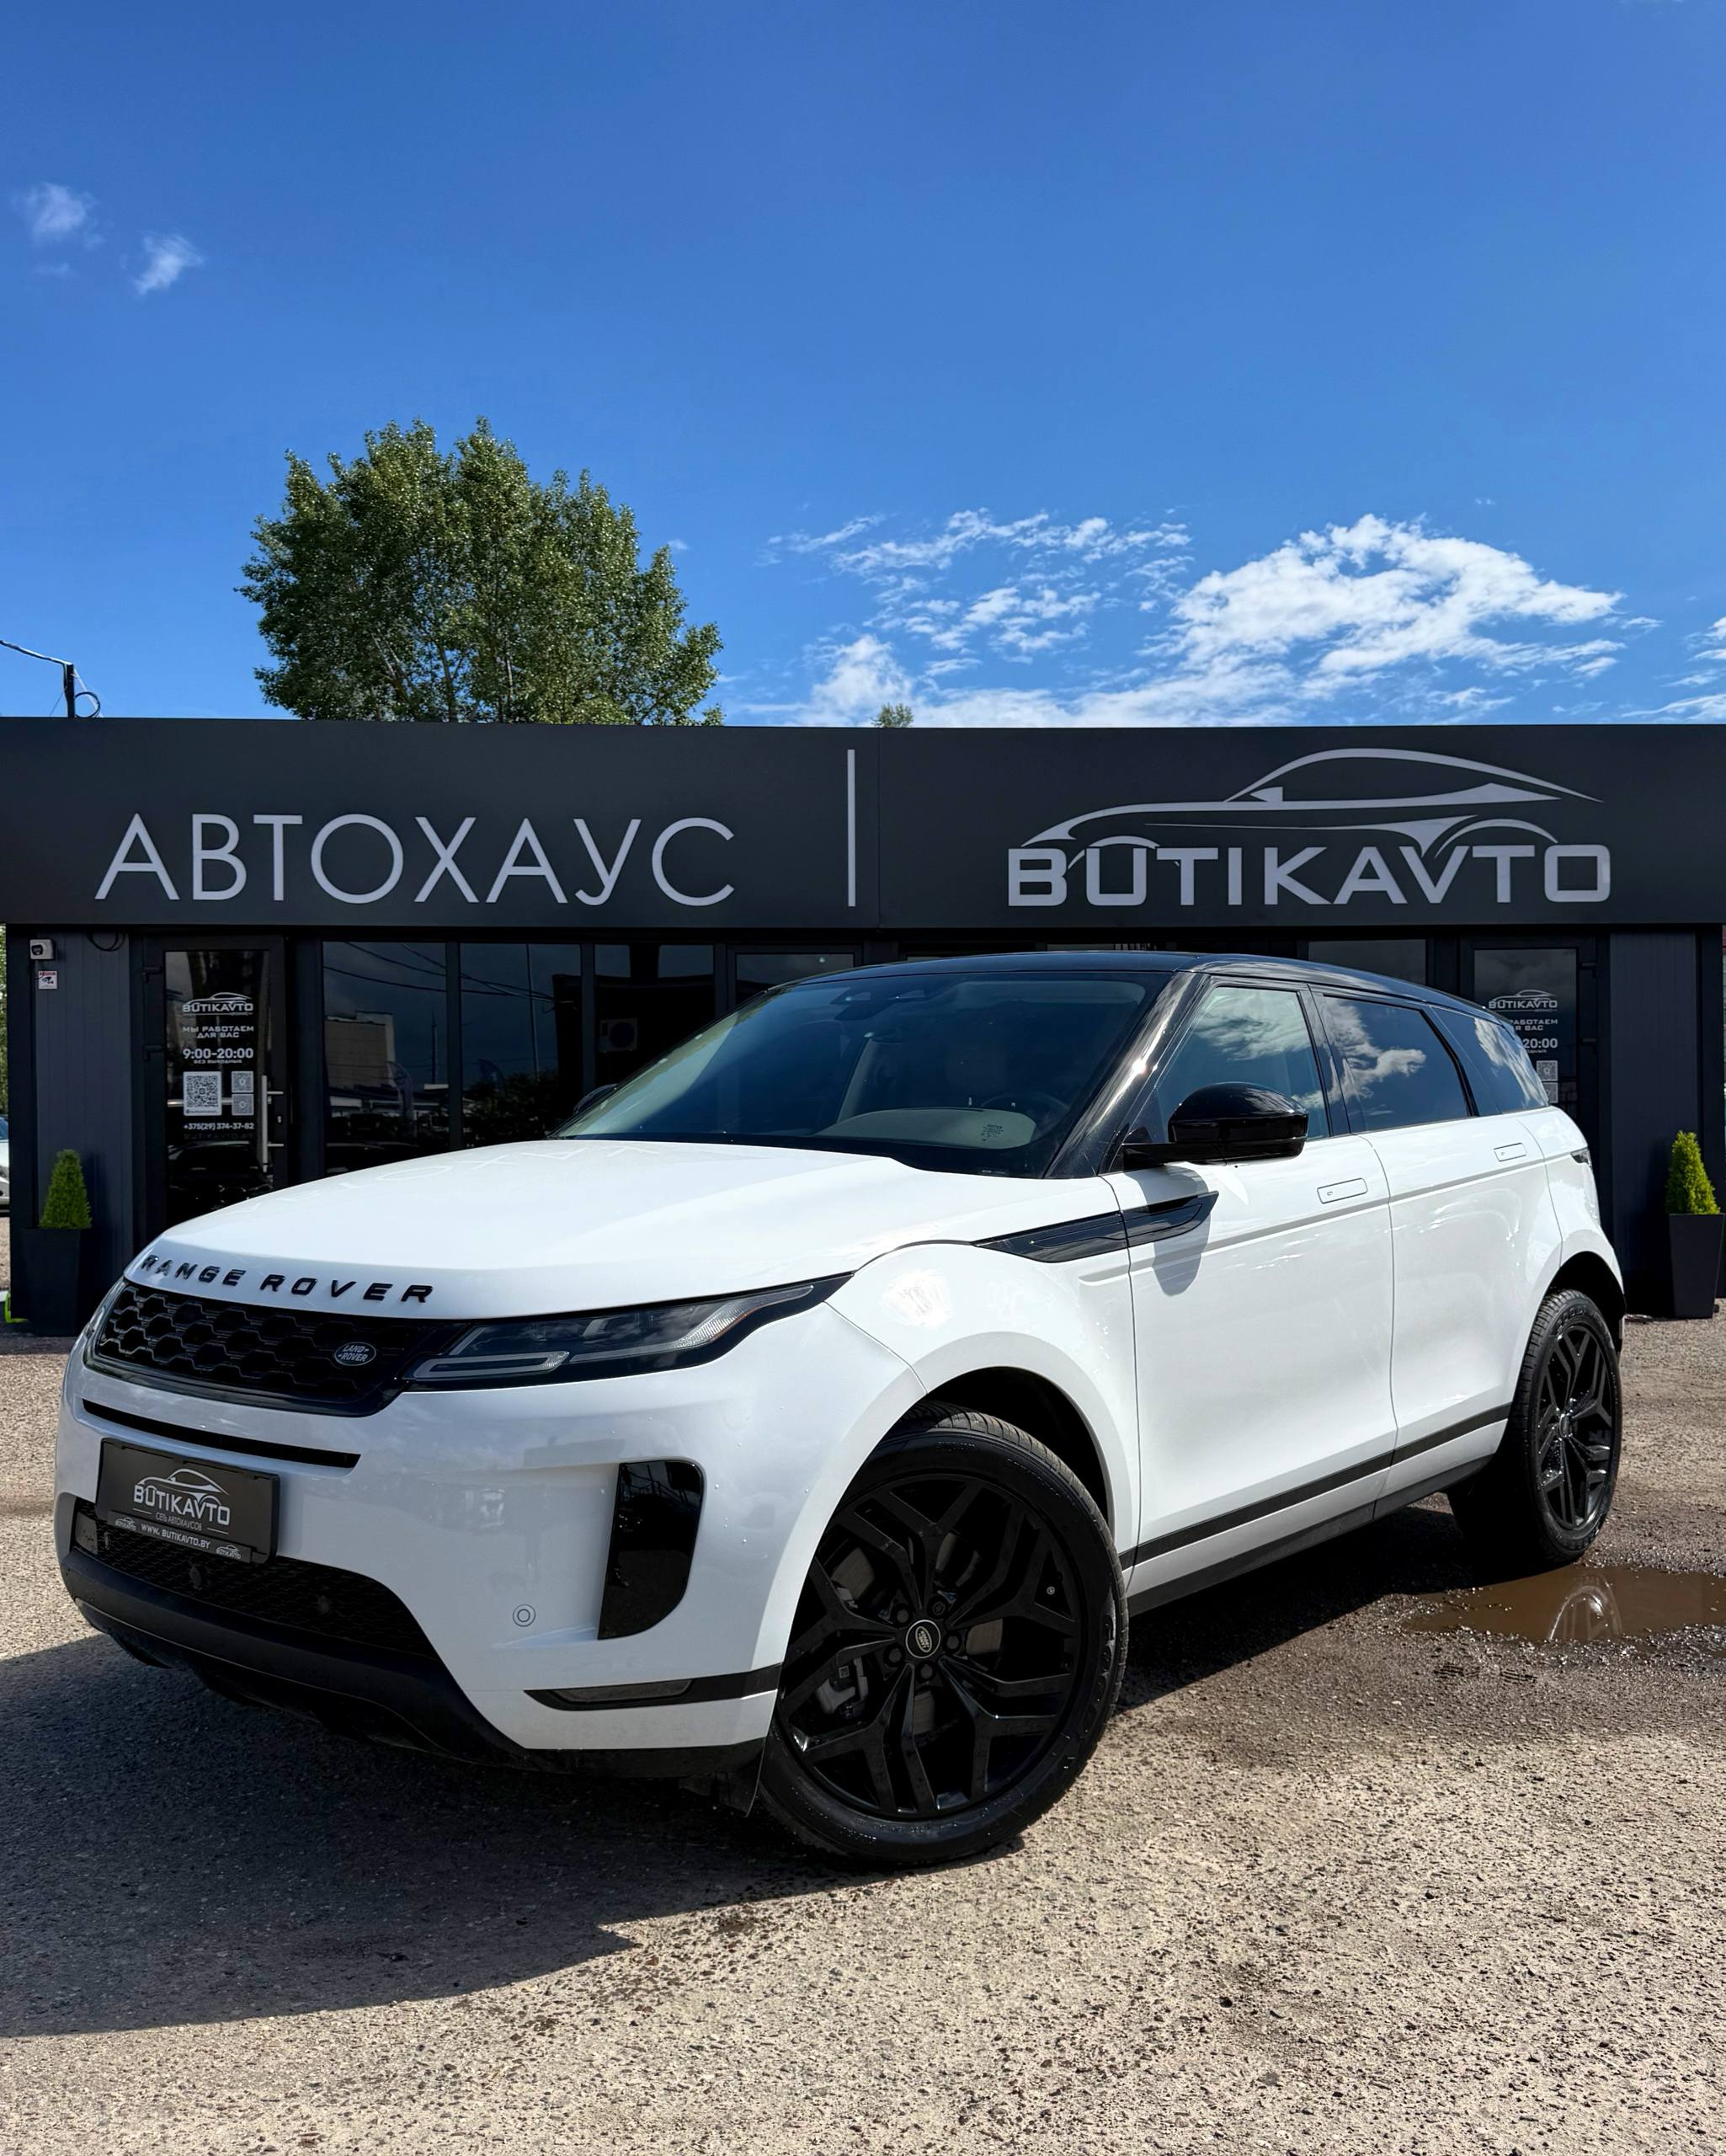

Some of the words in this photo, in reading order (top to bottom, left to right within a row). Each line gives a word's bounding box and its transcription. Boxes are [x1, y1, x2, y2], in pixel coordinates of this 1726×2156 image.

[93, 813, 736, 906] АВТОХАУС
[1008, 843, 1611, 907] BUTIKAVTO
[182, 1003, 253, 1012] BUTIKAVTO
[1488, 1001, 1558, 1009] BUTIKAVTO
[182, 1048, 254, 1059] 9:00-20:00
[139, 1254, 247, 1287] RANGE
[259, 1273, 434, 1304] ROVER
[133, 1484, 230, 1526] BUTIKAVTO
